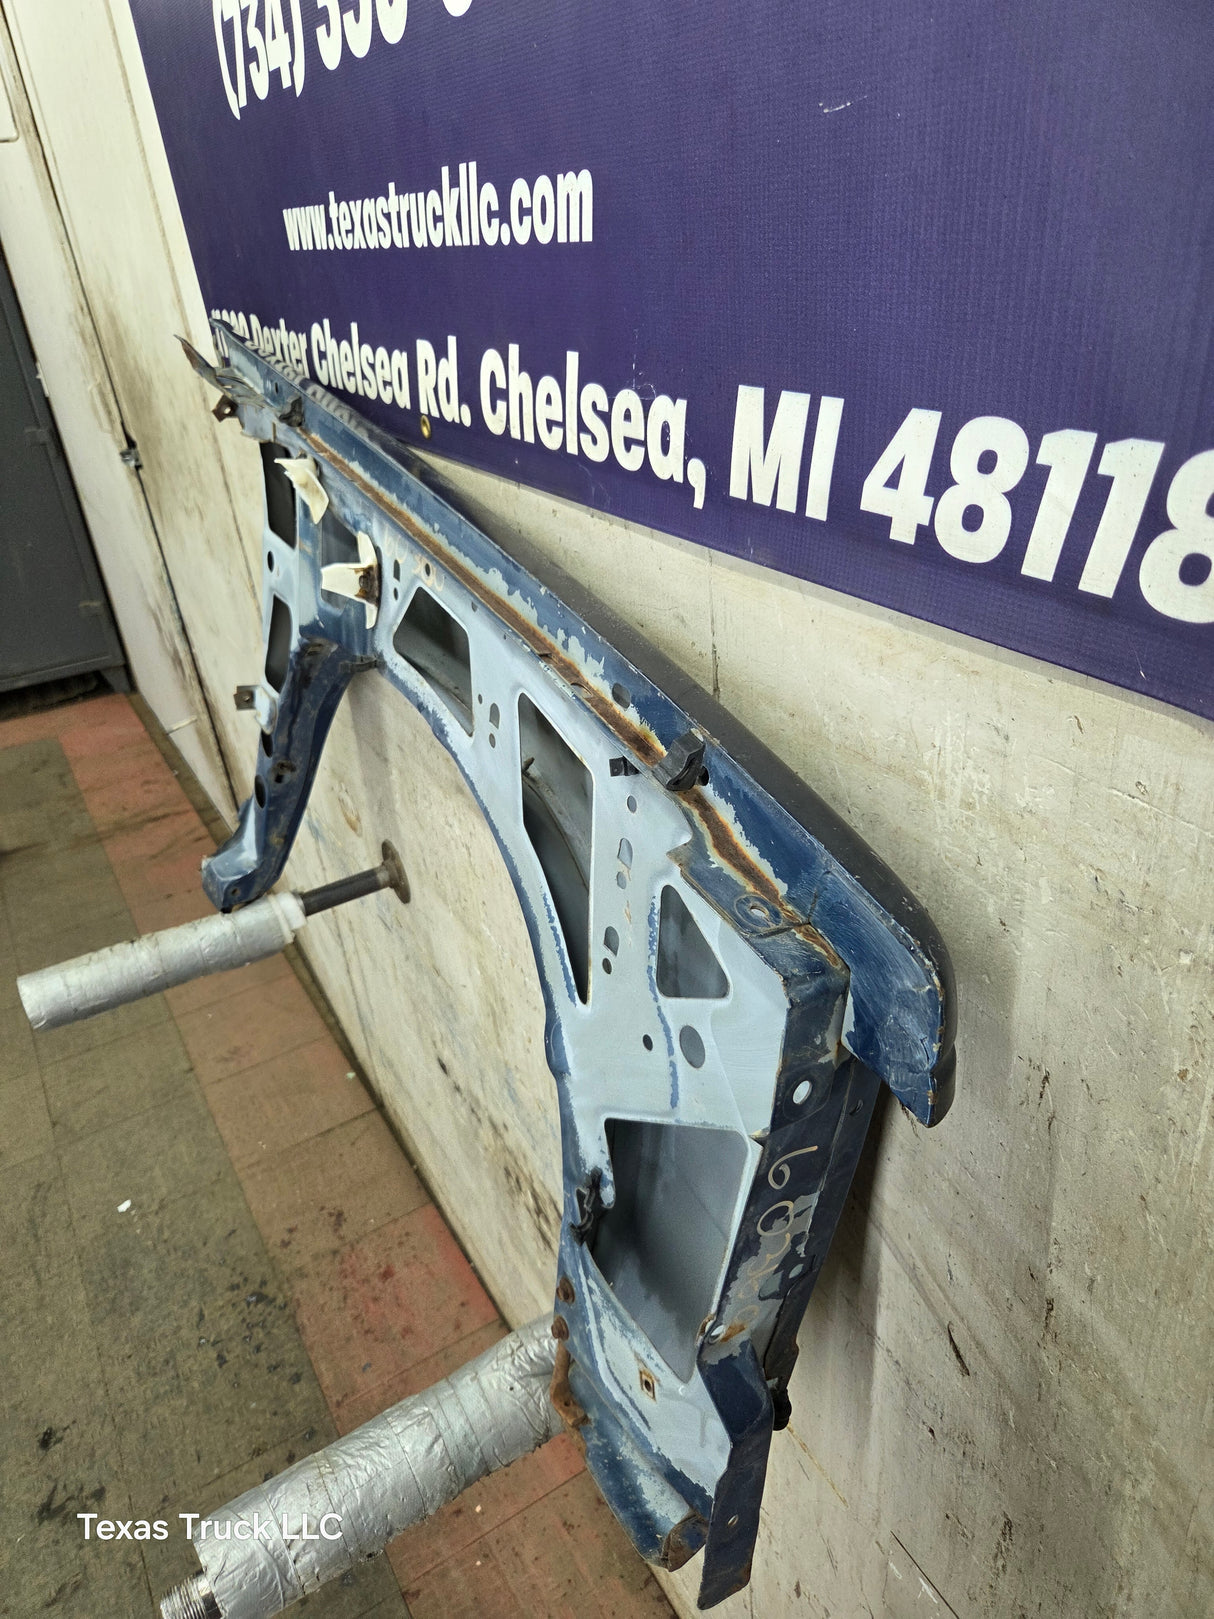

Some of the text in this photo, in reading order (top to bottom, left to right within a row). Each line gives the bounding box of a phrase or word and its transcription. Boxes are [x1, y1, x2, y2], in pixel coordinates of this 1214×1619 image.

[282, 161, 593, 251] www.texastruckllc.com
[311, 318, 411, 409] Chelsea
[416, 335, 472, 427] Rd.
[480, 344, 706, 509] Chelsea,
[729, 385, 844, 521] MI
[860, 408, 1214, 623] 48118
